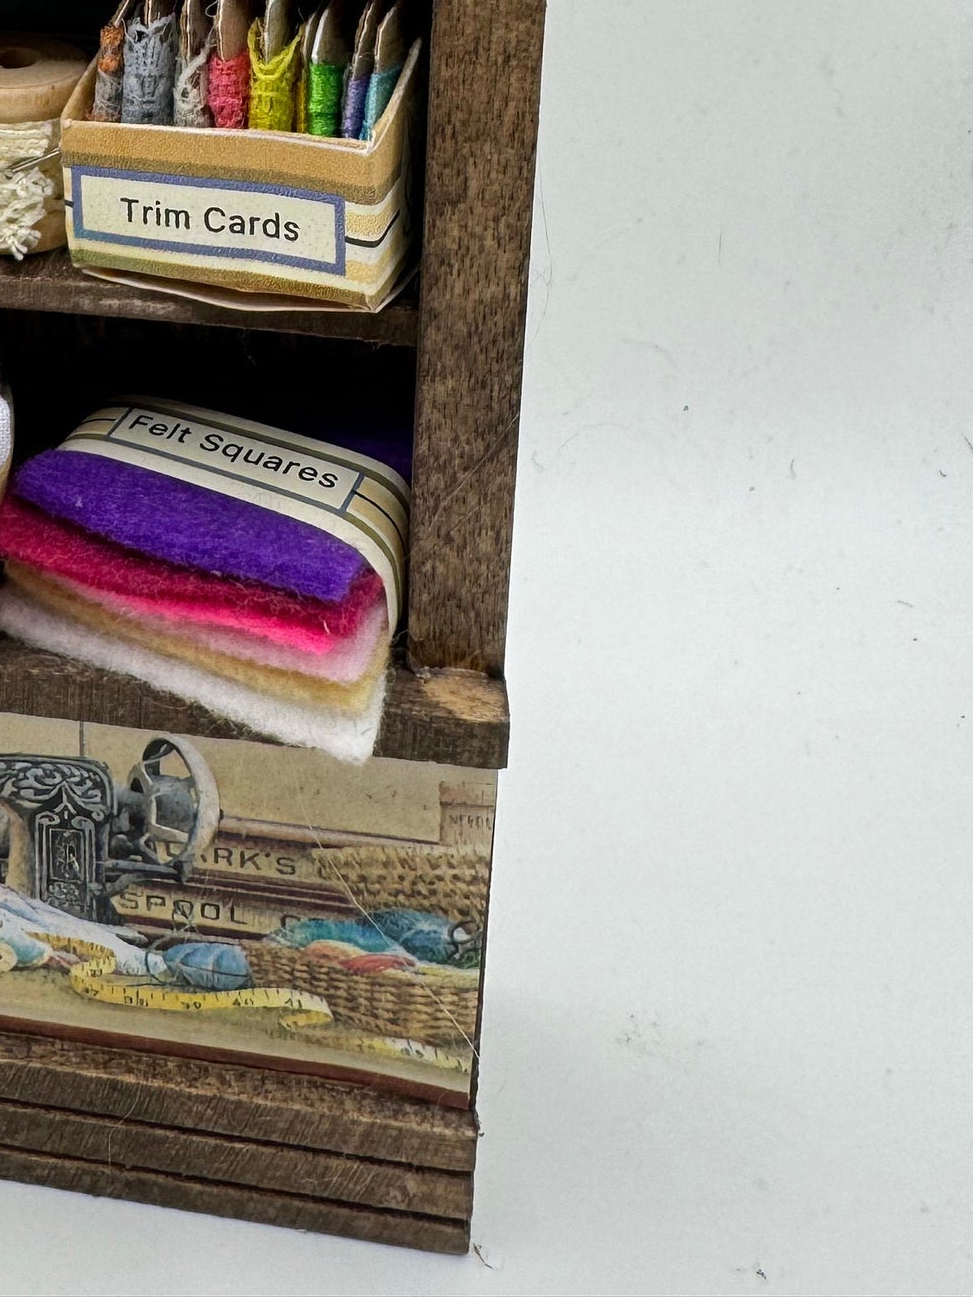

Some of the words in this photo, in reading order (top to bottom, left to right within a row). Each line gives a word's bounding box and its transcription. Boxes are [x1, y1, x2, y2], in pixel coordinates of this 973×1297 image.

[120, 197, 190, 230] Trim
[203, 206, 300, 242] Cards
[128, 414, 192, 445] Felt
[199, 433, 339, 489] Squares
[119, 891, 248, 926] SPOOL
